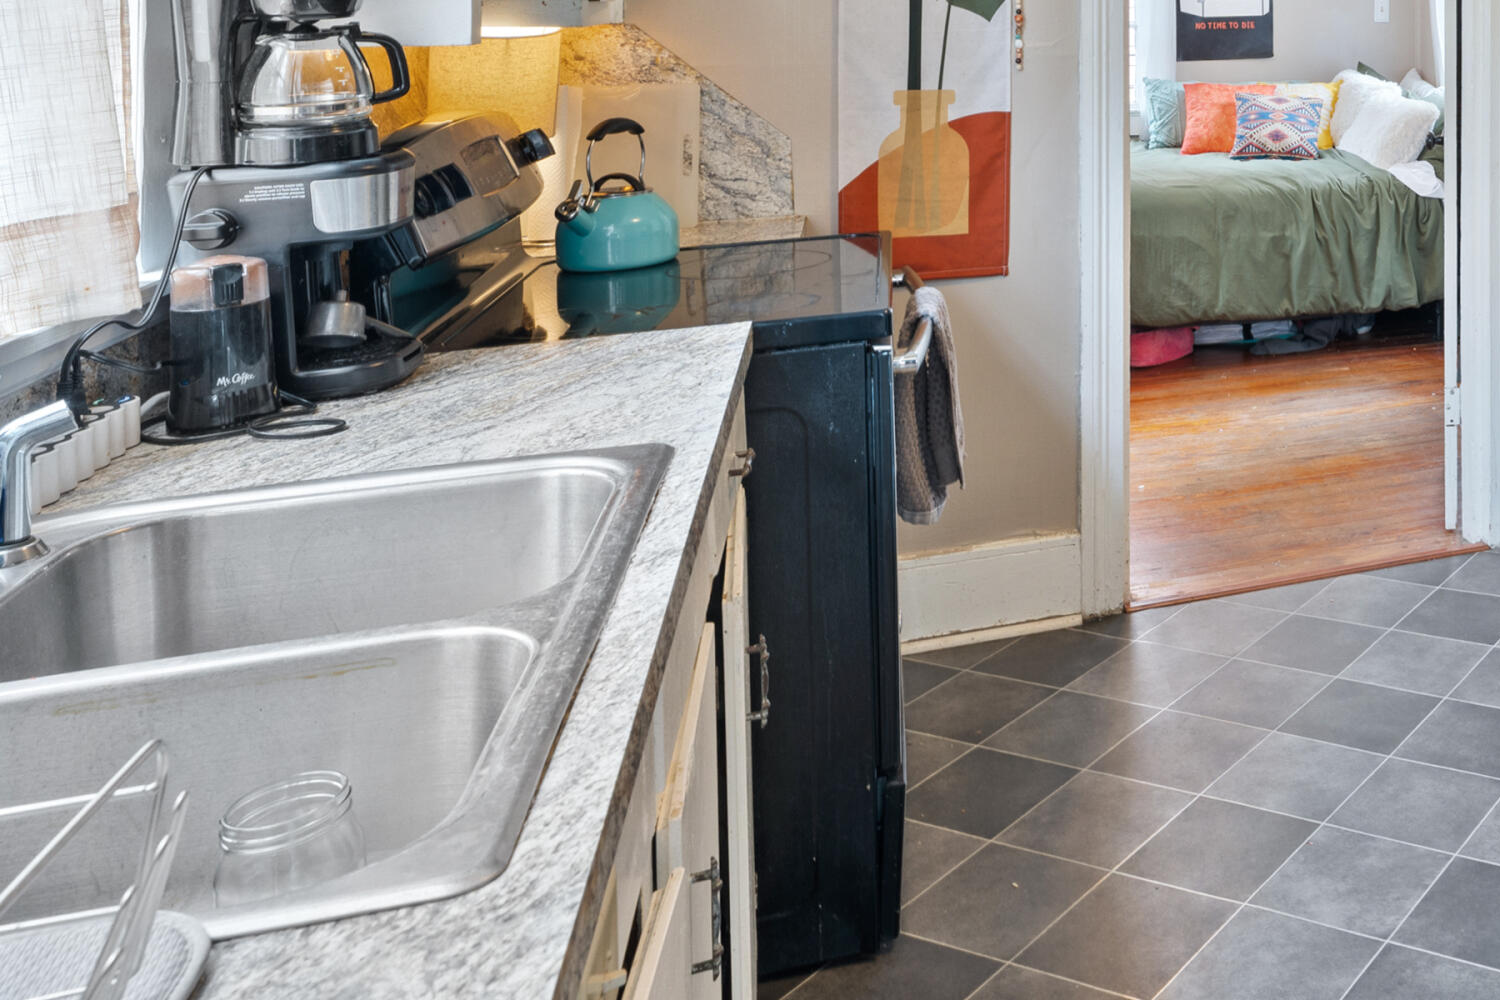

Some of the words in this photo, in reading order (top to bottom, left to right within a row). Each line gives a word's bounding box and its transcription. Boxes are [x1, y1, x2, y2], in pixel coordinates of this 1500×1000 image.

[1195, 21, 1207, 30] NO
[1208, 21, 1227, 30] TIME
[1228, 21, 1239, 29] TO
[1241, 20, 1255, 29] DIE
[216, 376, 231, 387] Mr.
[232, 371, 255, 385] Coffee
